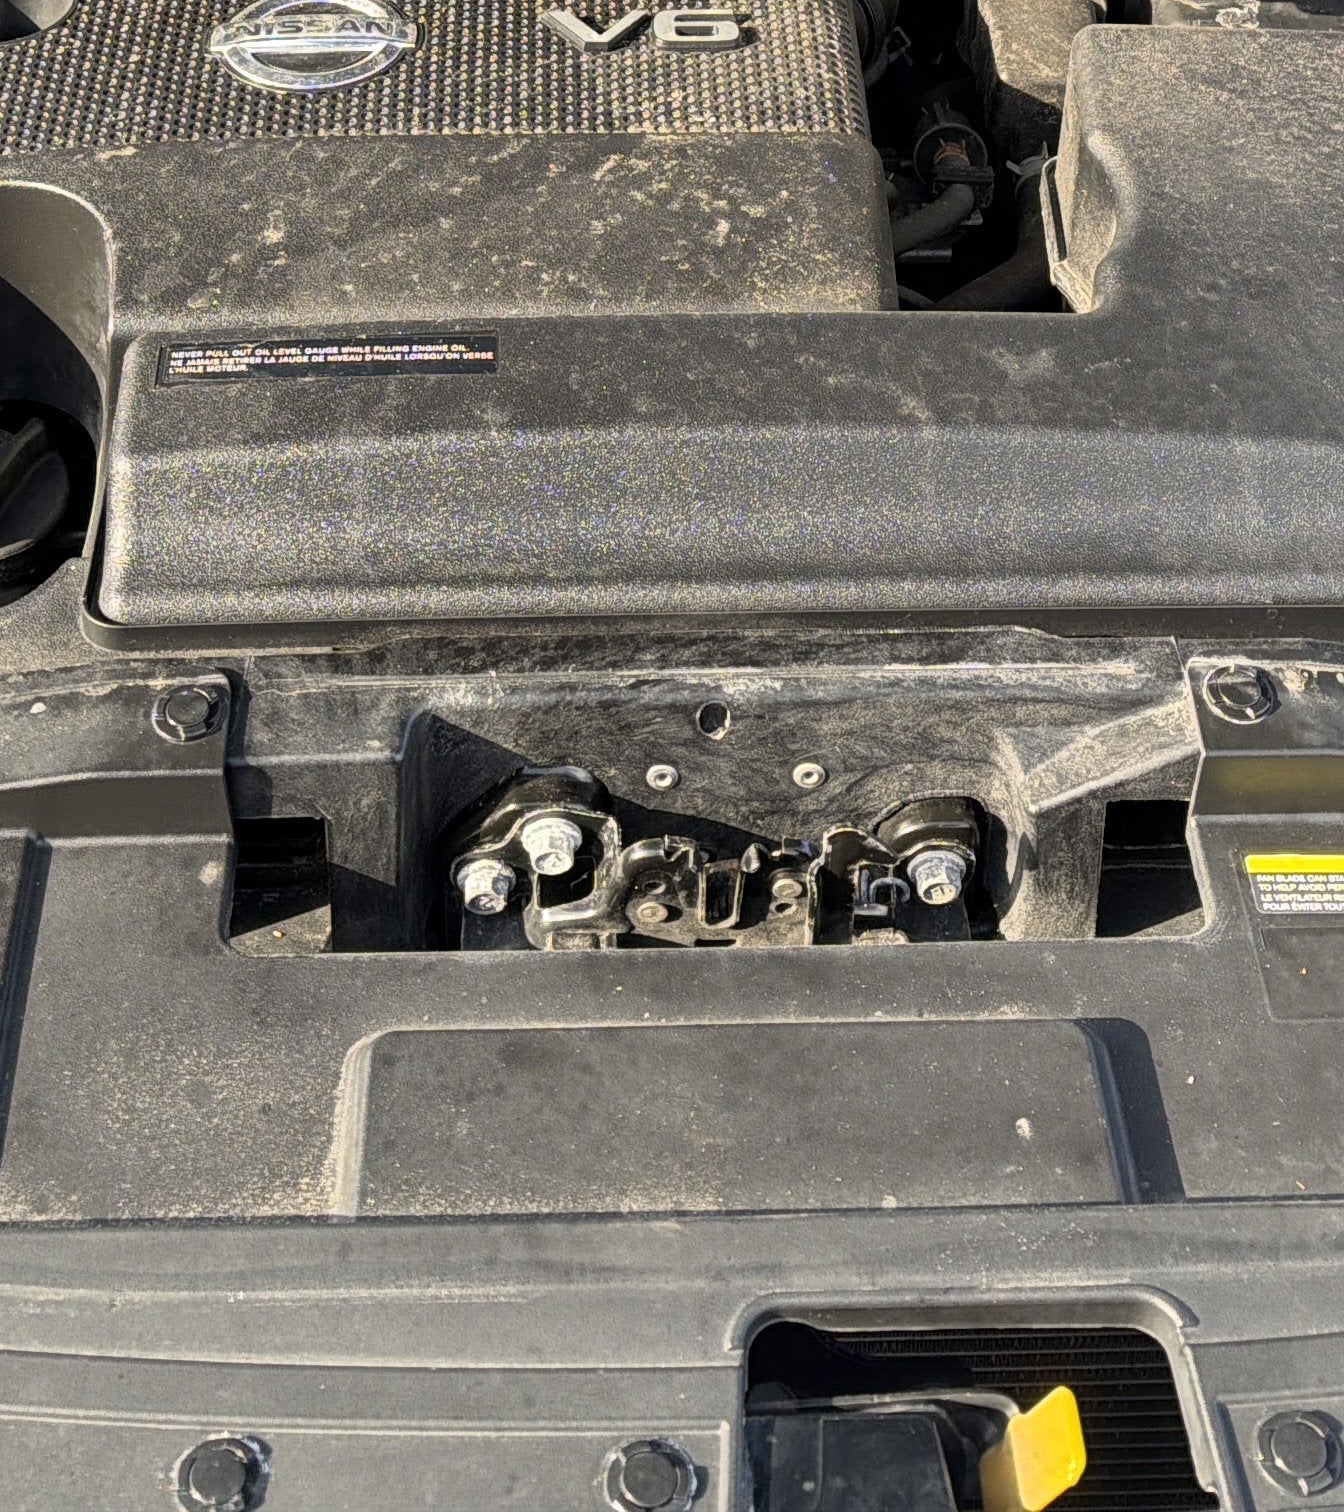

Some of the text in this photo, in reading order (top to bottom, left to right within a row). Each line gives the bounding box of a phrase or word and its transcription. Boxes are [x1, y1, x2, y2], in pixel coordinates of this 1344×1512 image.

[226, 18, 396, 38] NISSAN
[543, 9, 745, 52] V6
[170, 359, 183, 367] NE
[186, 358, 220, 366] JAMAIS
[222, 357, 262, 365] RETIRER
[264, 356, 276, 364] LA
[279, 355, 309, 364] JAUGE
[311, 355, 325, 363] DE
[327, 353, 363, 362] NIVEAU
[365, 353, 402, 361] D'HUILE
[462, 351, 494, 360] VERSE
[171, 350, 203, 359] NEVER
[205, 349, 229, 358] PULL
[232, 348, 253, 357] OUT
[254, 347, 270, 356] OIL
[273, 347, 301, 355] LEVEL
[304, 346, 338, 355] GAUGE
[341, 345, 371, 354] WHILE
[373, 344, 409, 353] FILLING
[411, 344, 448, 352] ENGINE
[1306, 875, 1327, 883] CAN
[1261, 894, 1274, 902] LE
